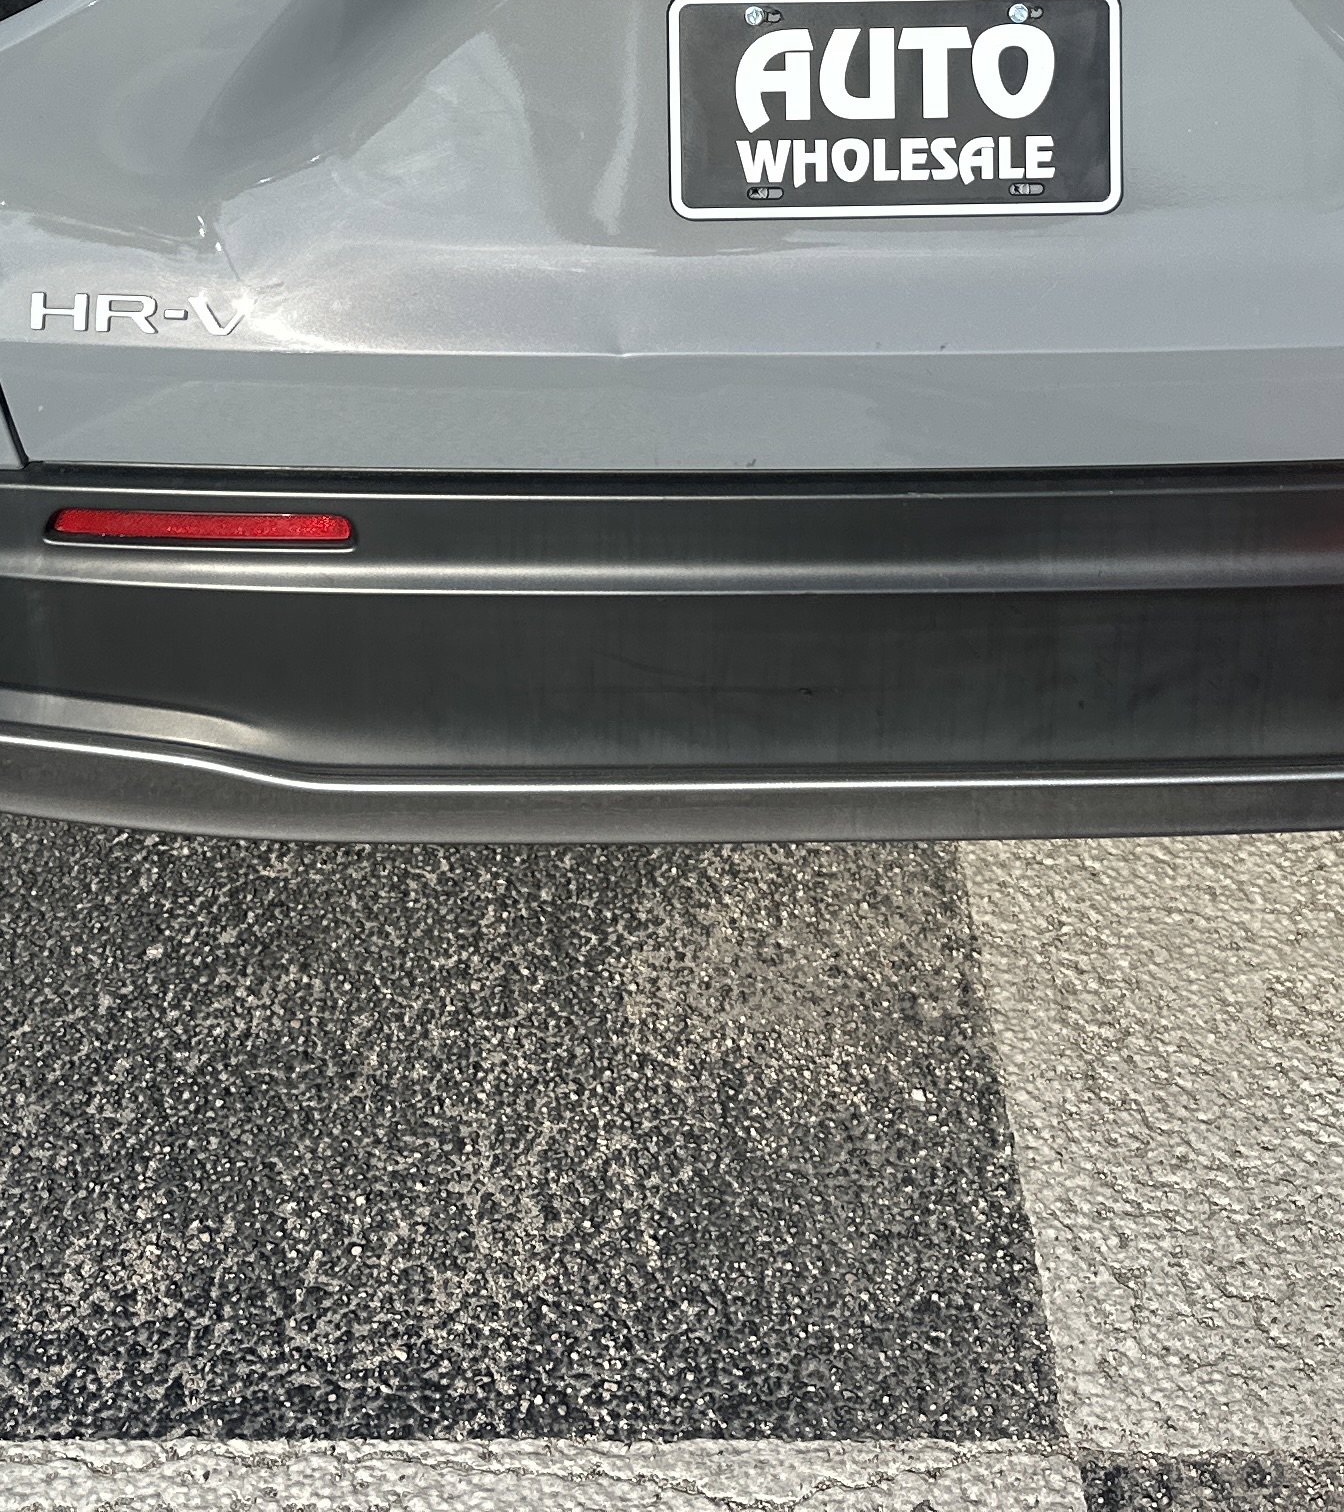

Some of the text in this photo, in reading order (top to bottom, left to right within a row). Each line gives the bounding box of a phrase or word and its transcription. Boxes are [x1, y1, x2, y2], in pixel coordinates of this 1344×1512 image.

[735, 23, 1056, 134] AUTO
[735, 135, 1056, 189] WHOLESALE
[30, 291, 249, 336] HR-V
